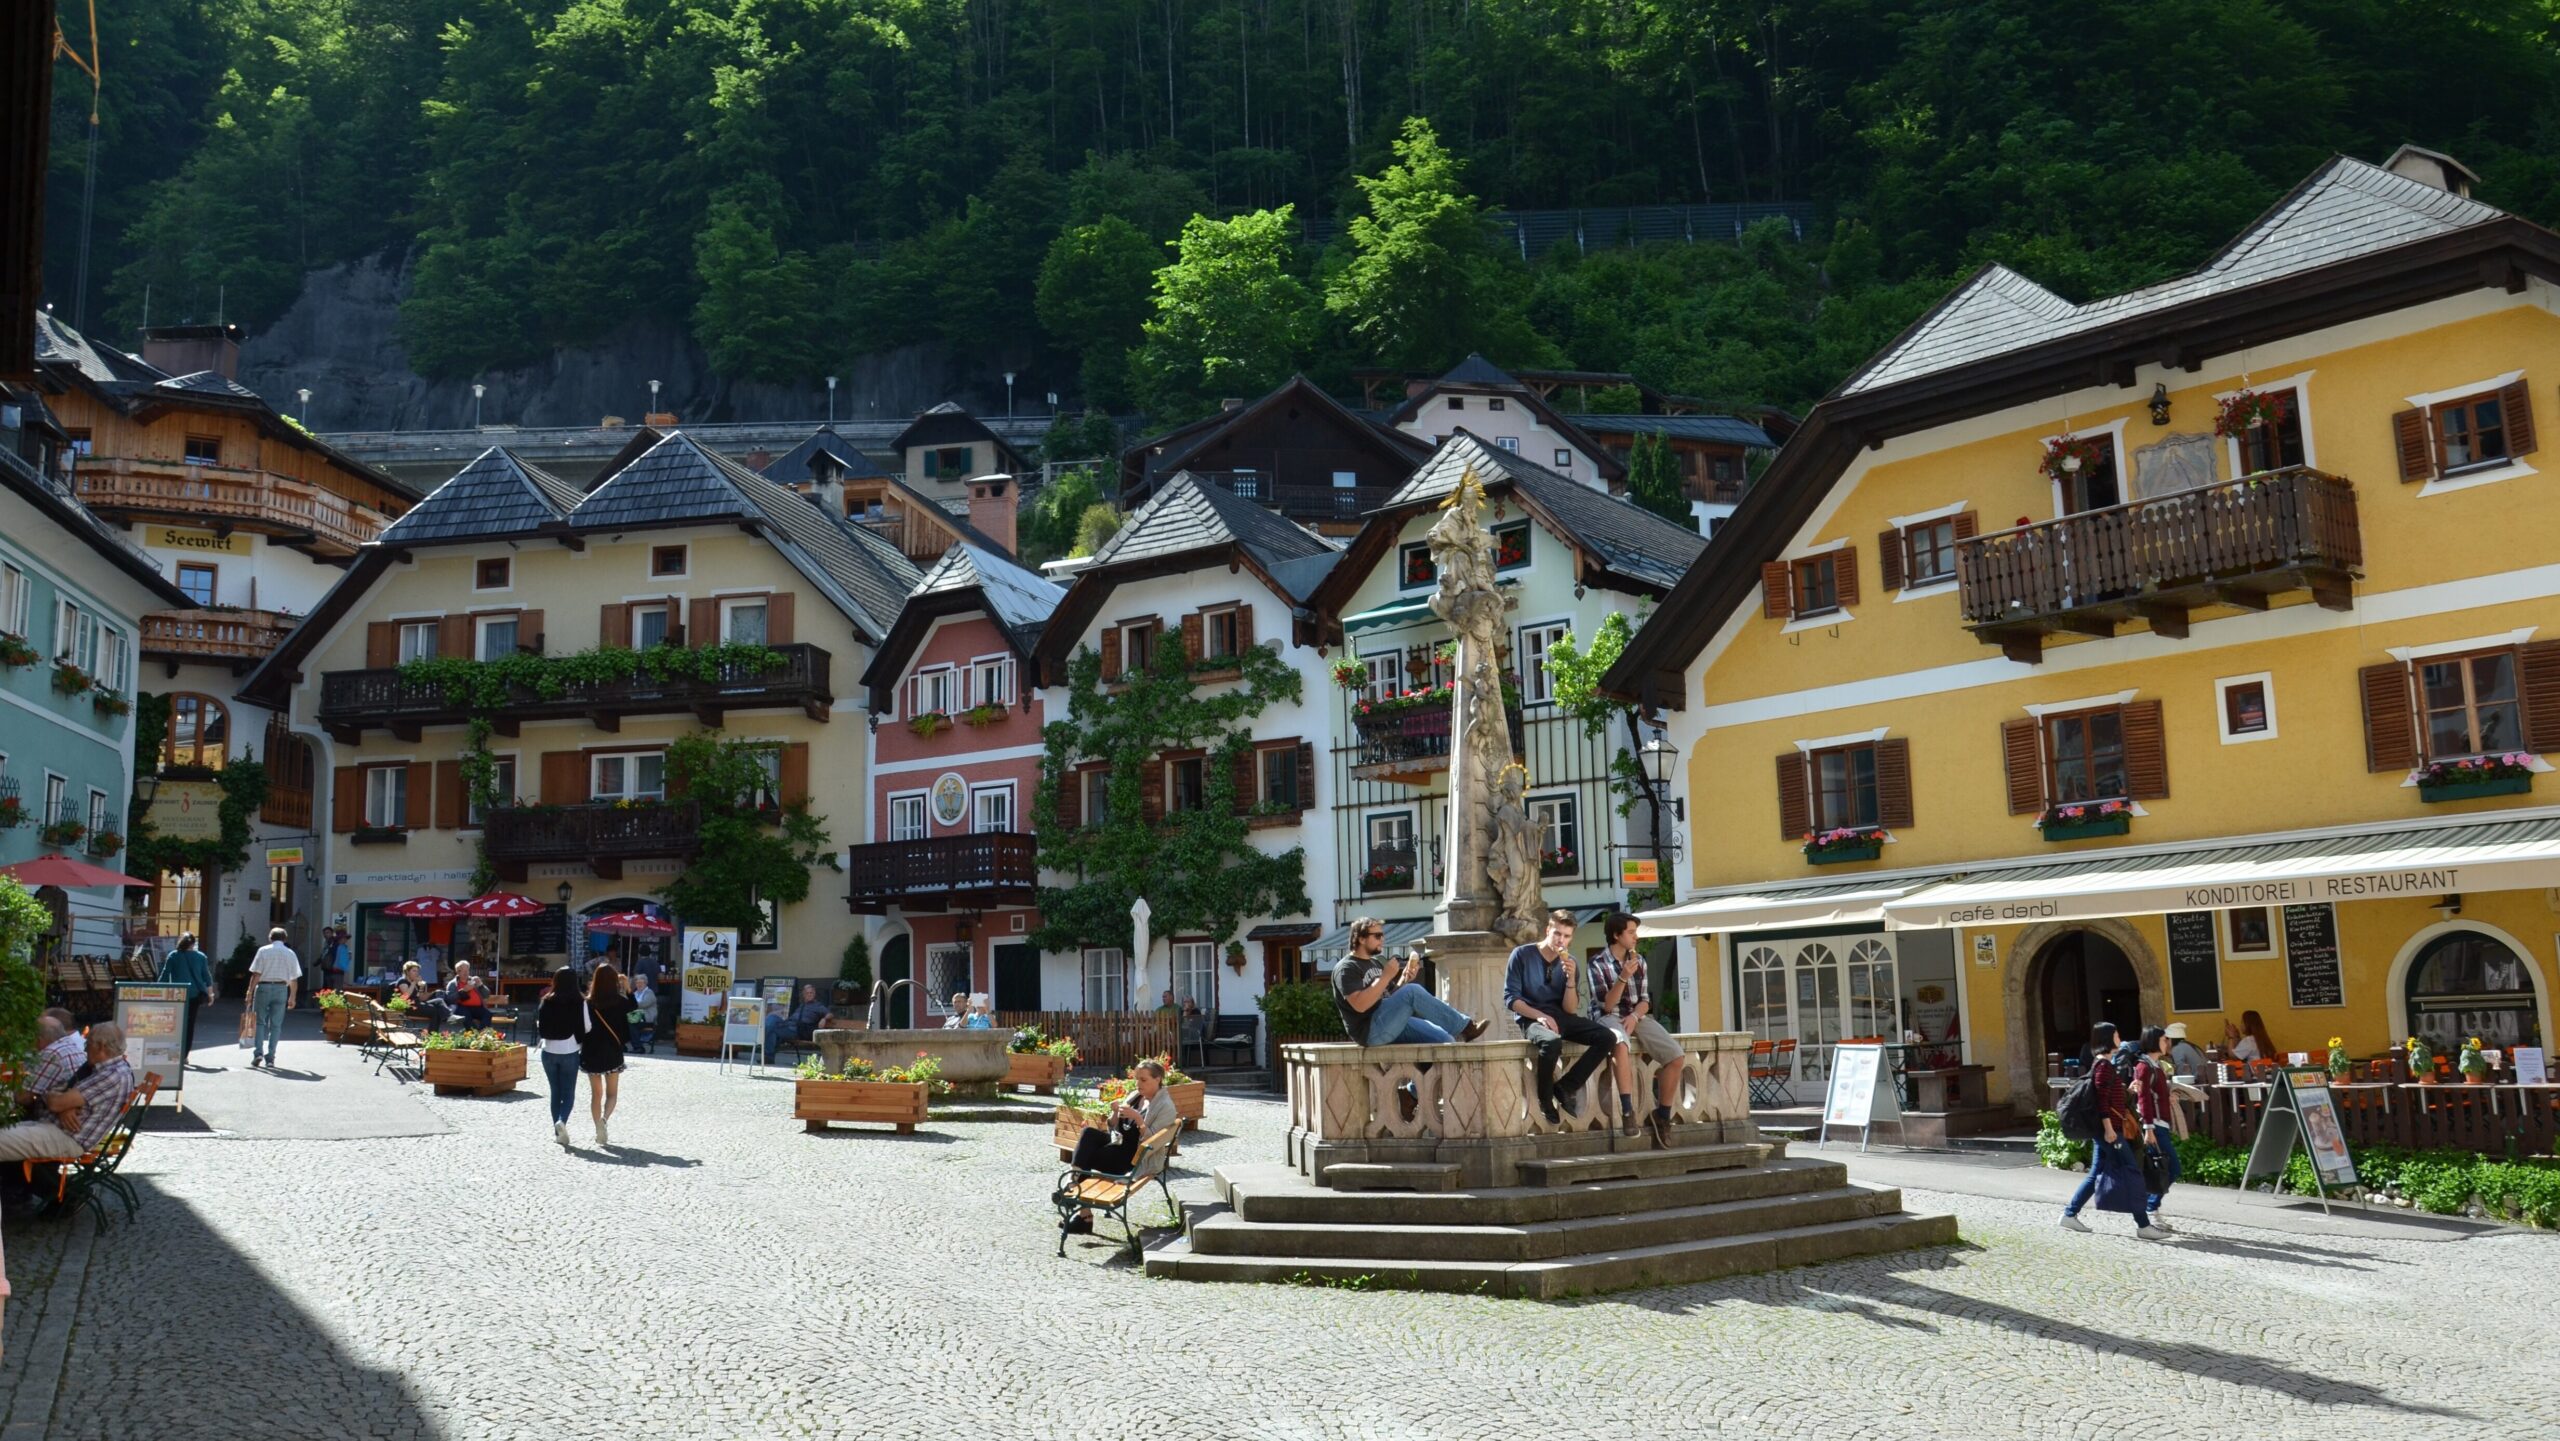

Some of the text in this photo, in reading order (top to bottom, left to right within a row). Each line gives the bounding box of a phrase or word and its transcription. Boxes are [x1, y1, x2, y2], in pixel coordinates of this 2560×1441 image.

[165, 529, 232, 550] Seewirt
[368, 873, 426, 883] marktladen
[2186, 882, 2295, 906] KONDITOREI
[2328, 869, 2459, 896] RESTAURANT
[1950, 905, 1995, 922] café
[687, 974, 705, 988] DAS
